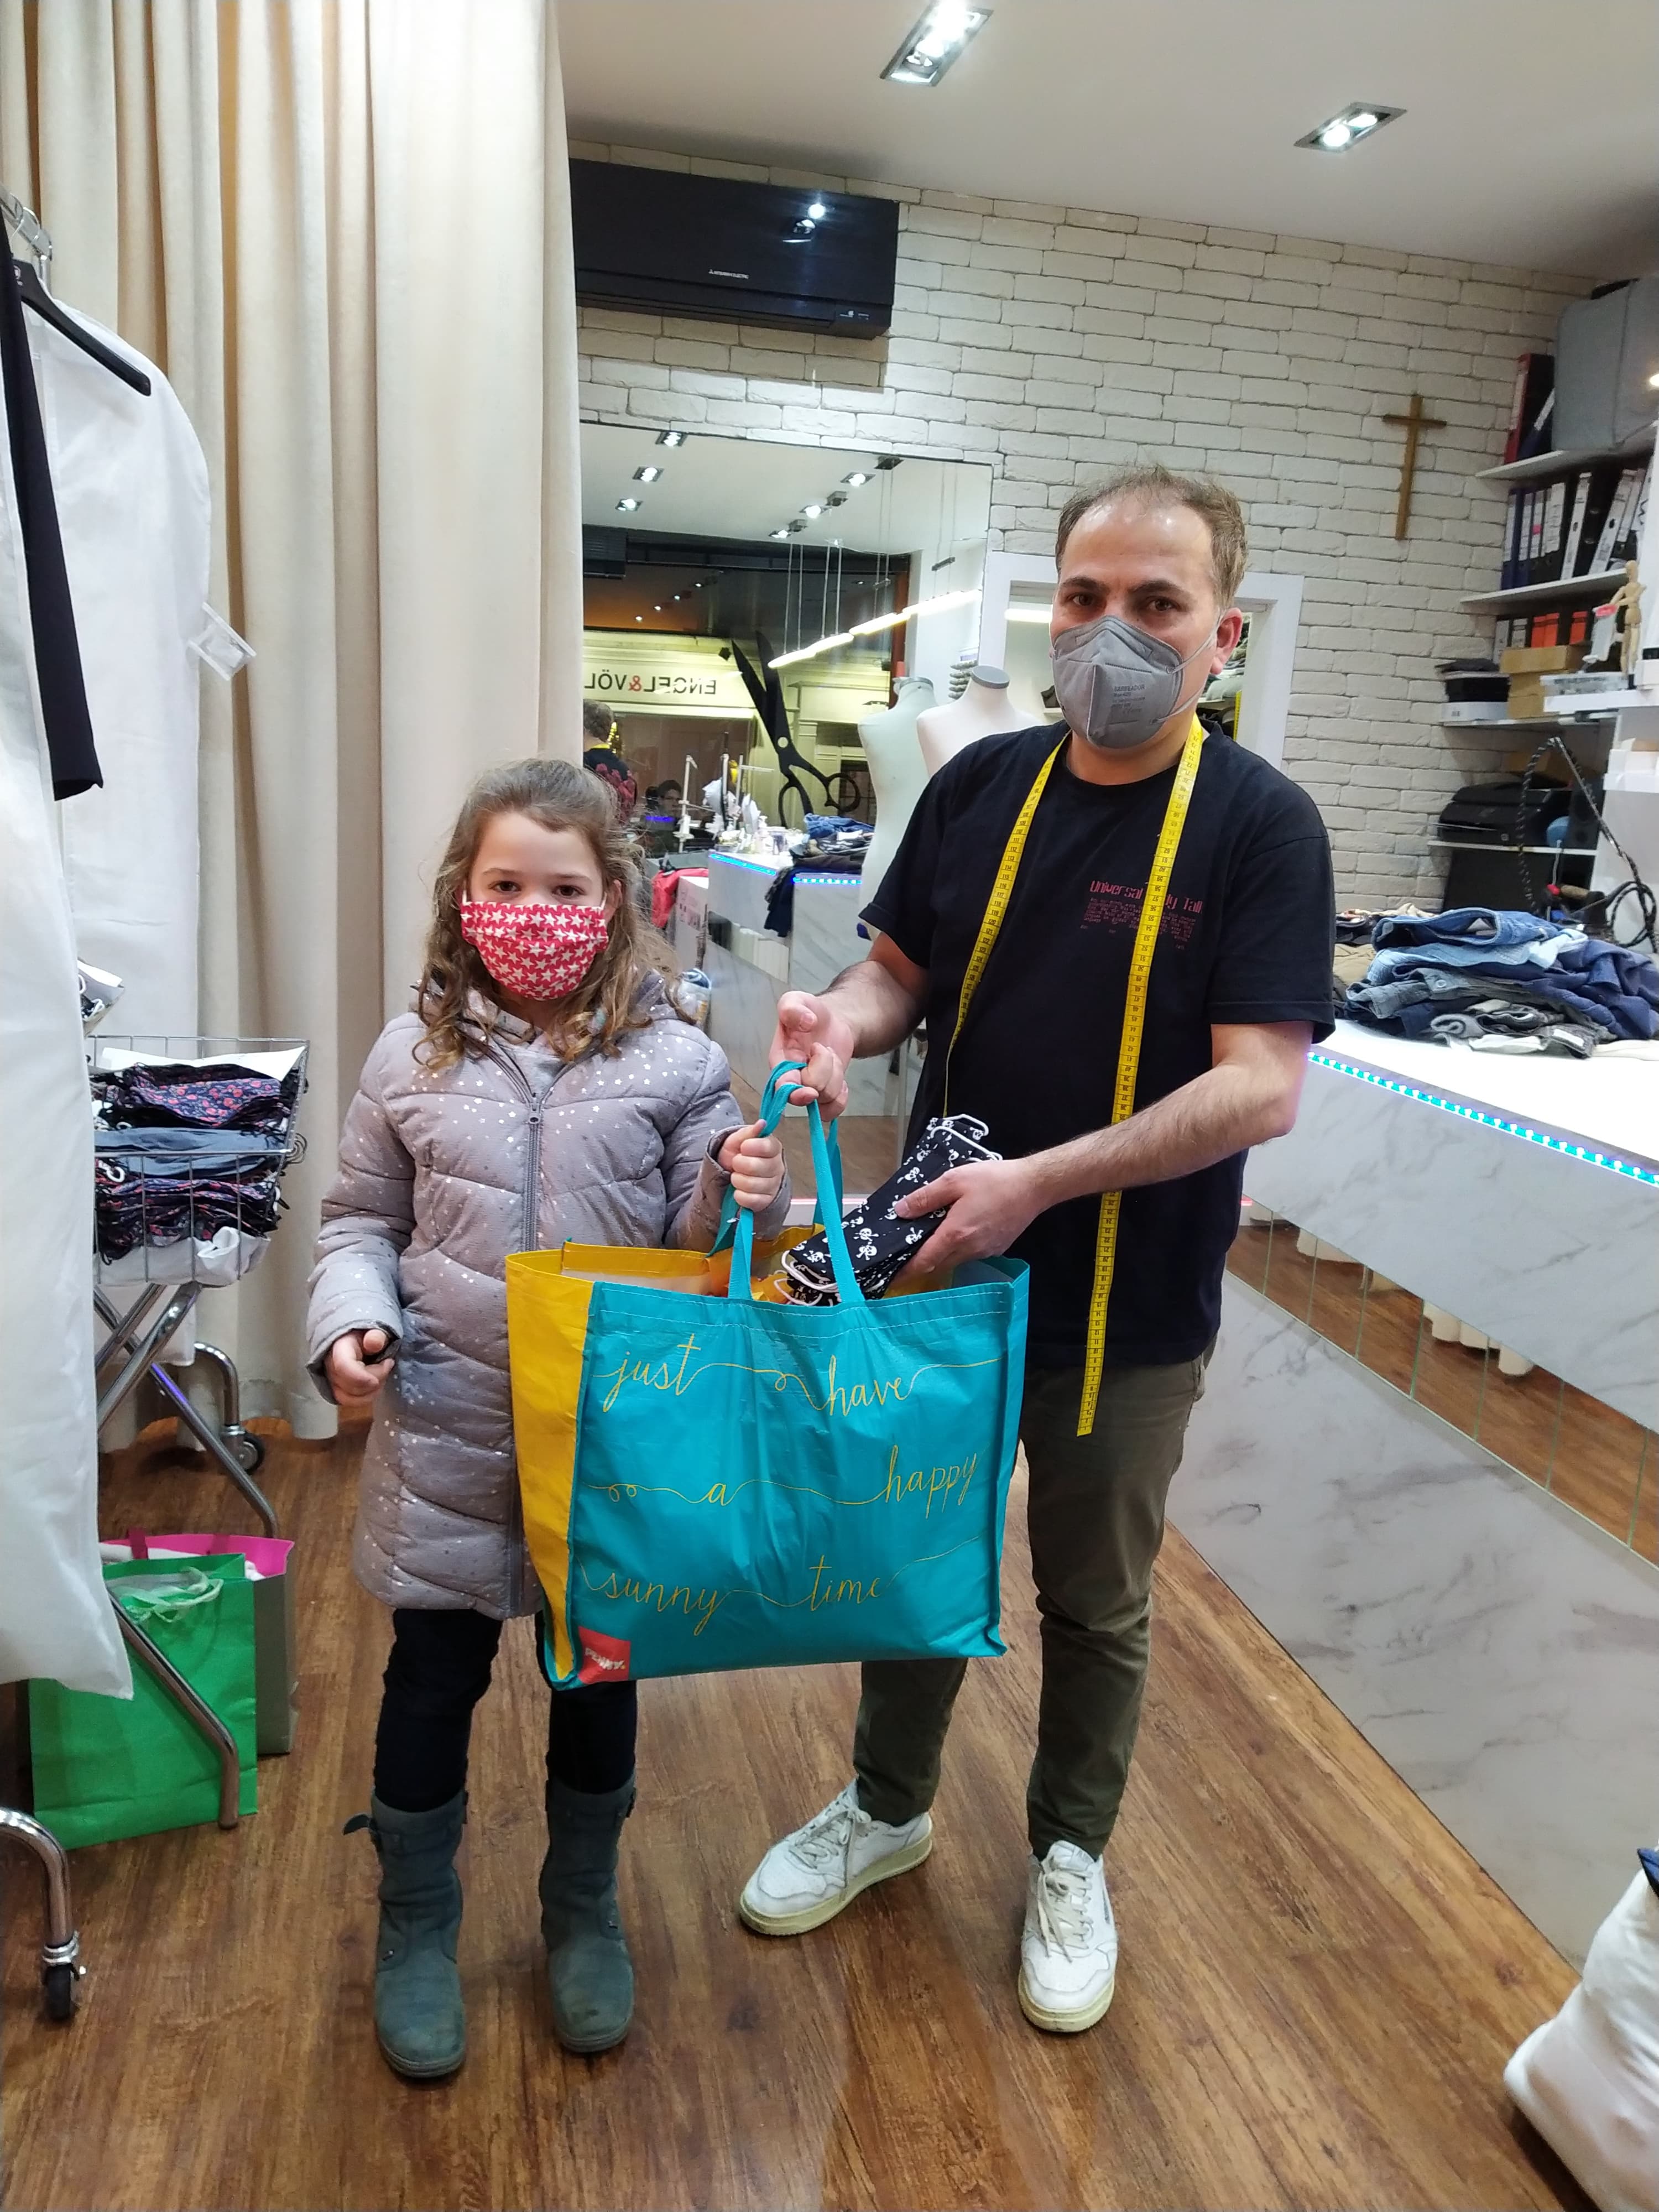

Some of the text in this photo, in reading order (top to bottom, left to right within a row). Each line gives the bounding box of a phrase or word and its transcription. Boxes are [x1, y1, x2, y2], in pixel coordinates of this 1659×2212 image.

[601, 1333, 911, 1416] just have
[706, 1444, 977, 1519] a happy
[604, 1554, 881, 1636] sunny time
